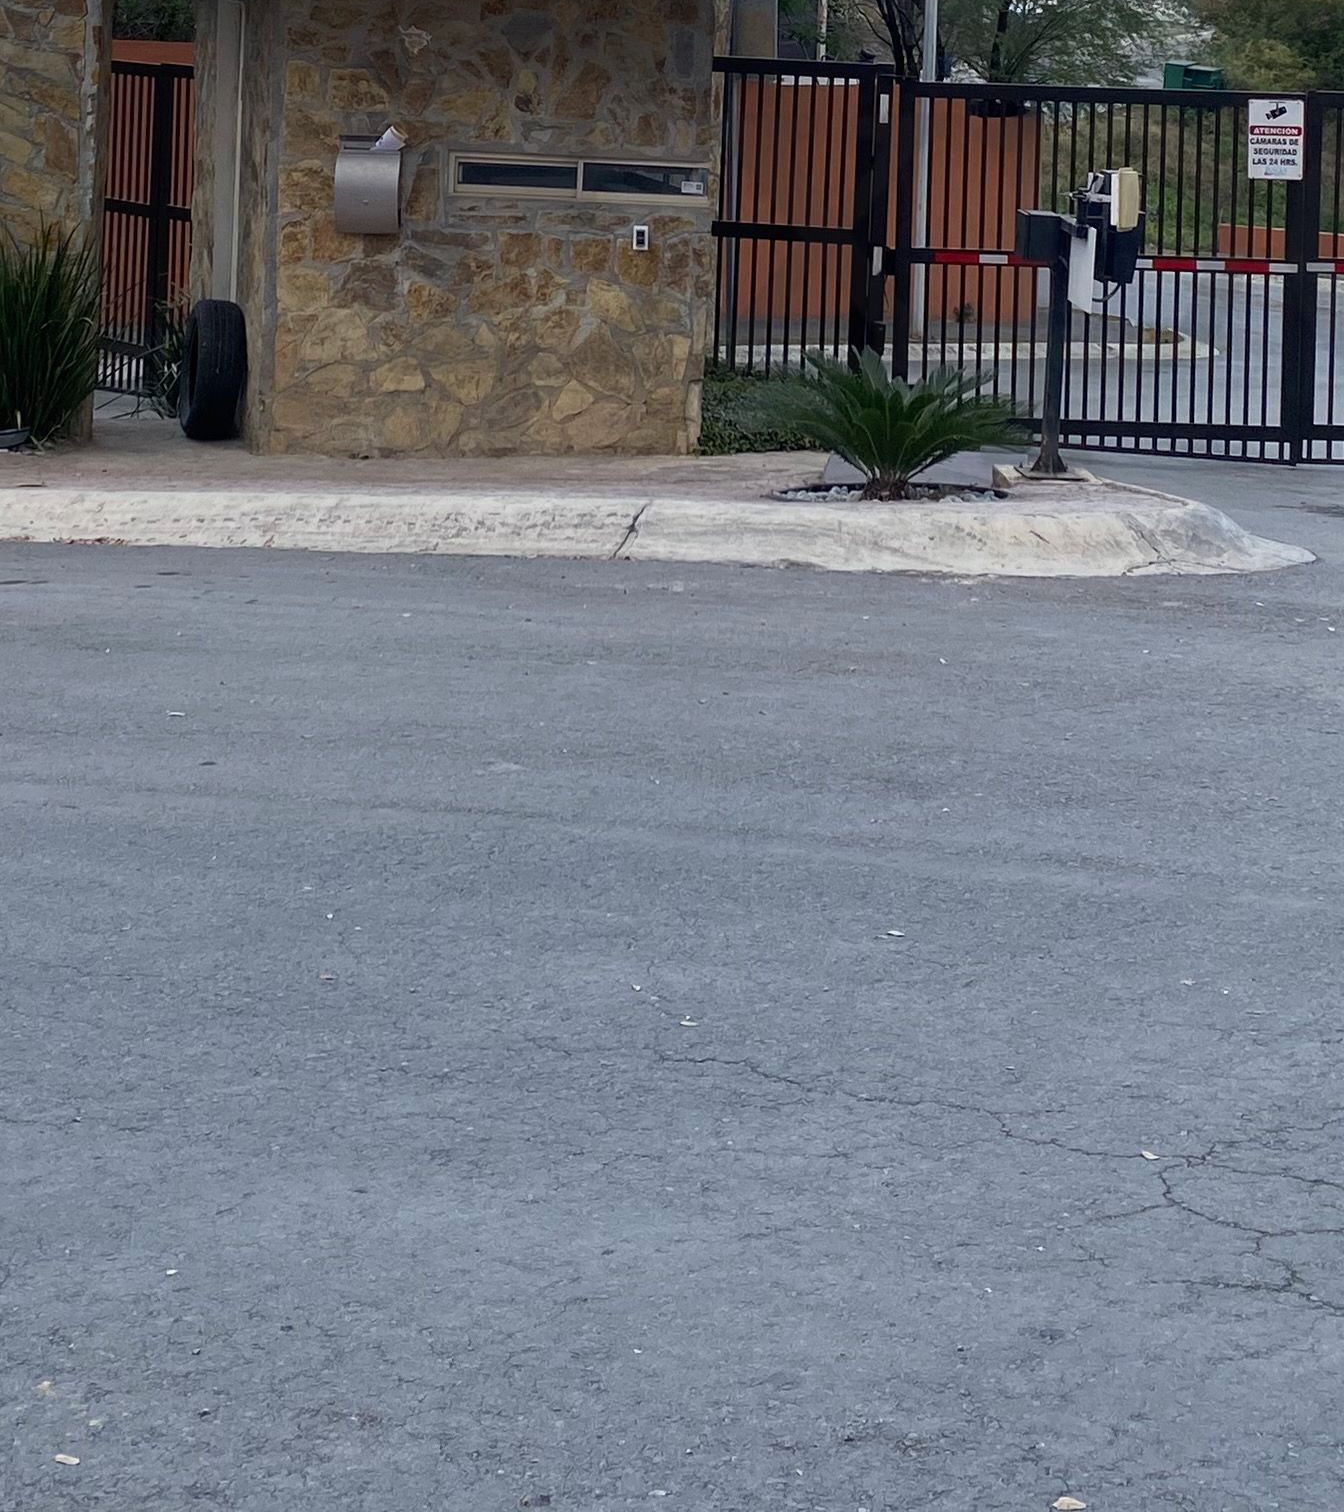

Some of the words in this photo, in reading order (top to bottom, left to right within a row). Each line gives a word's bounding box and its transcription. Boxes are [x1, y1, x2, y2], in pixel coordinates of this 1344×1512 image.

[1289, 138, 1299, 146] DE
[1253, 148, 1297, 156] SEGURIDAD
[1269, 158, 1278, 166] 24
[1280, 158, 1298, 166] HRS.
